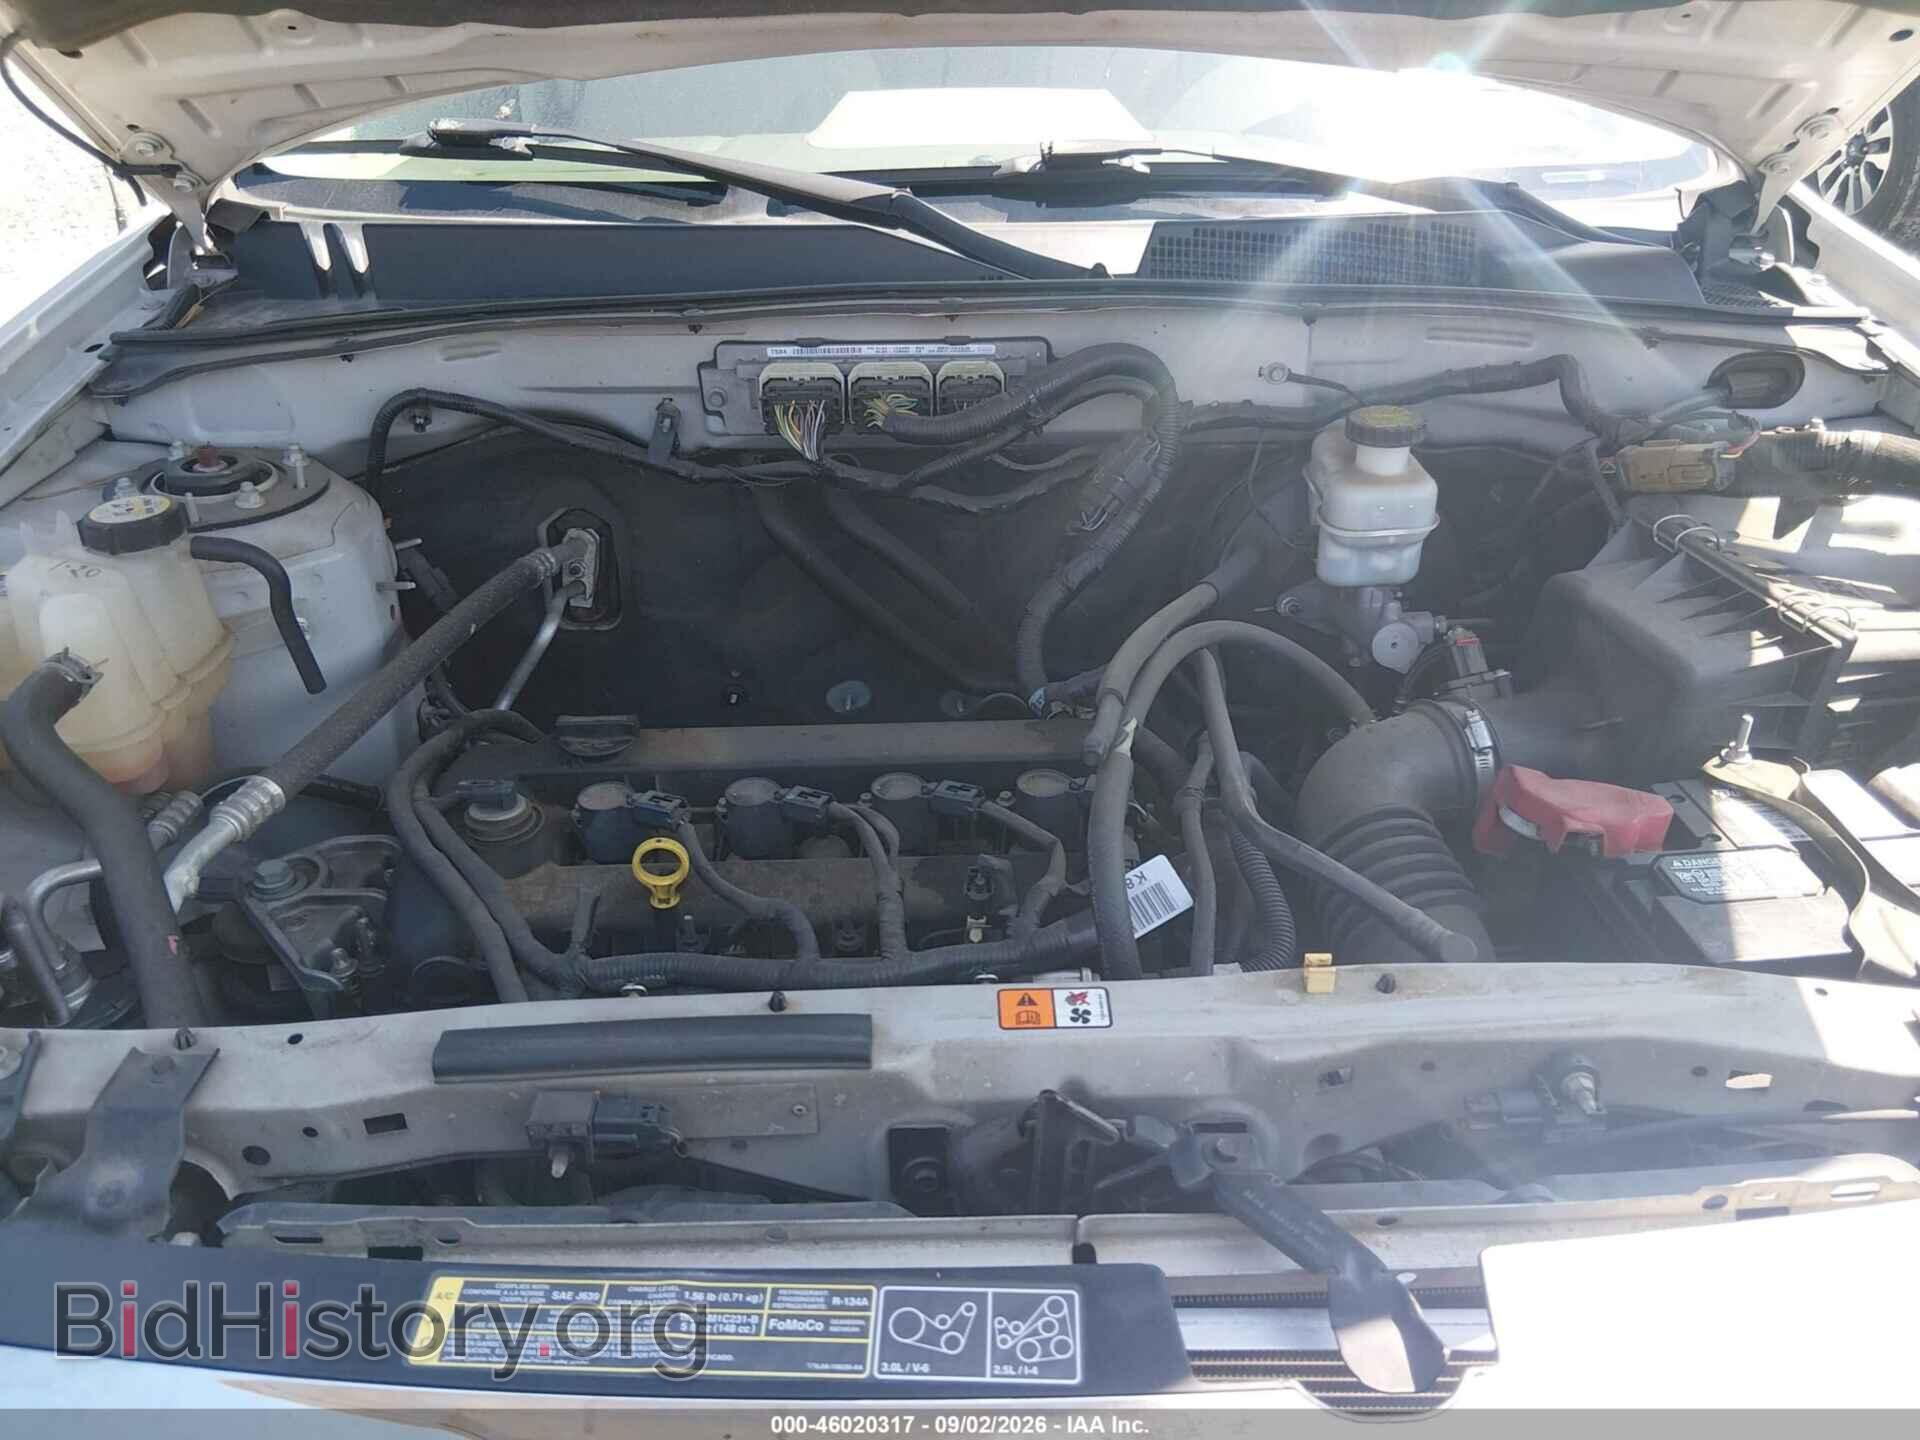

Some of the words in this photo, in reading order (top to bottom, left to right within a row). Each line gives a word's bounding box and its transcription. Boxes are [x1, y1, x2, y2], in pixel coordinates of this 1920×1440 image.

[551, 1290, 574, 1301] SAE
[831, 1296, 869, 1307] R-134A
[768, 1318, 825, 1332] FoMoCo
[880, 1361, 904, 1373] 3.0L
[911, 1362, 931, 1374] V-6
[993, 1364, 1017, 1375] 2.5L
